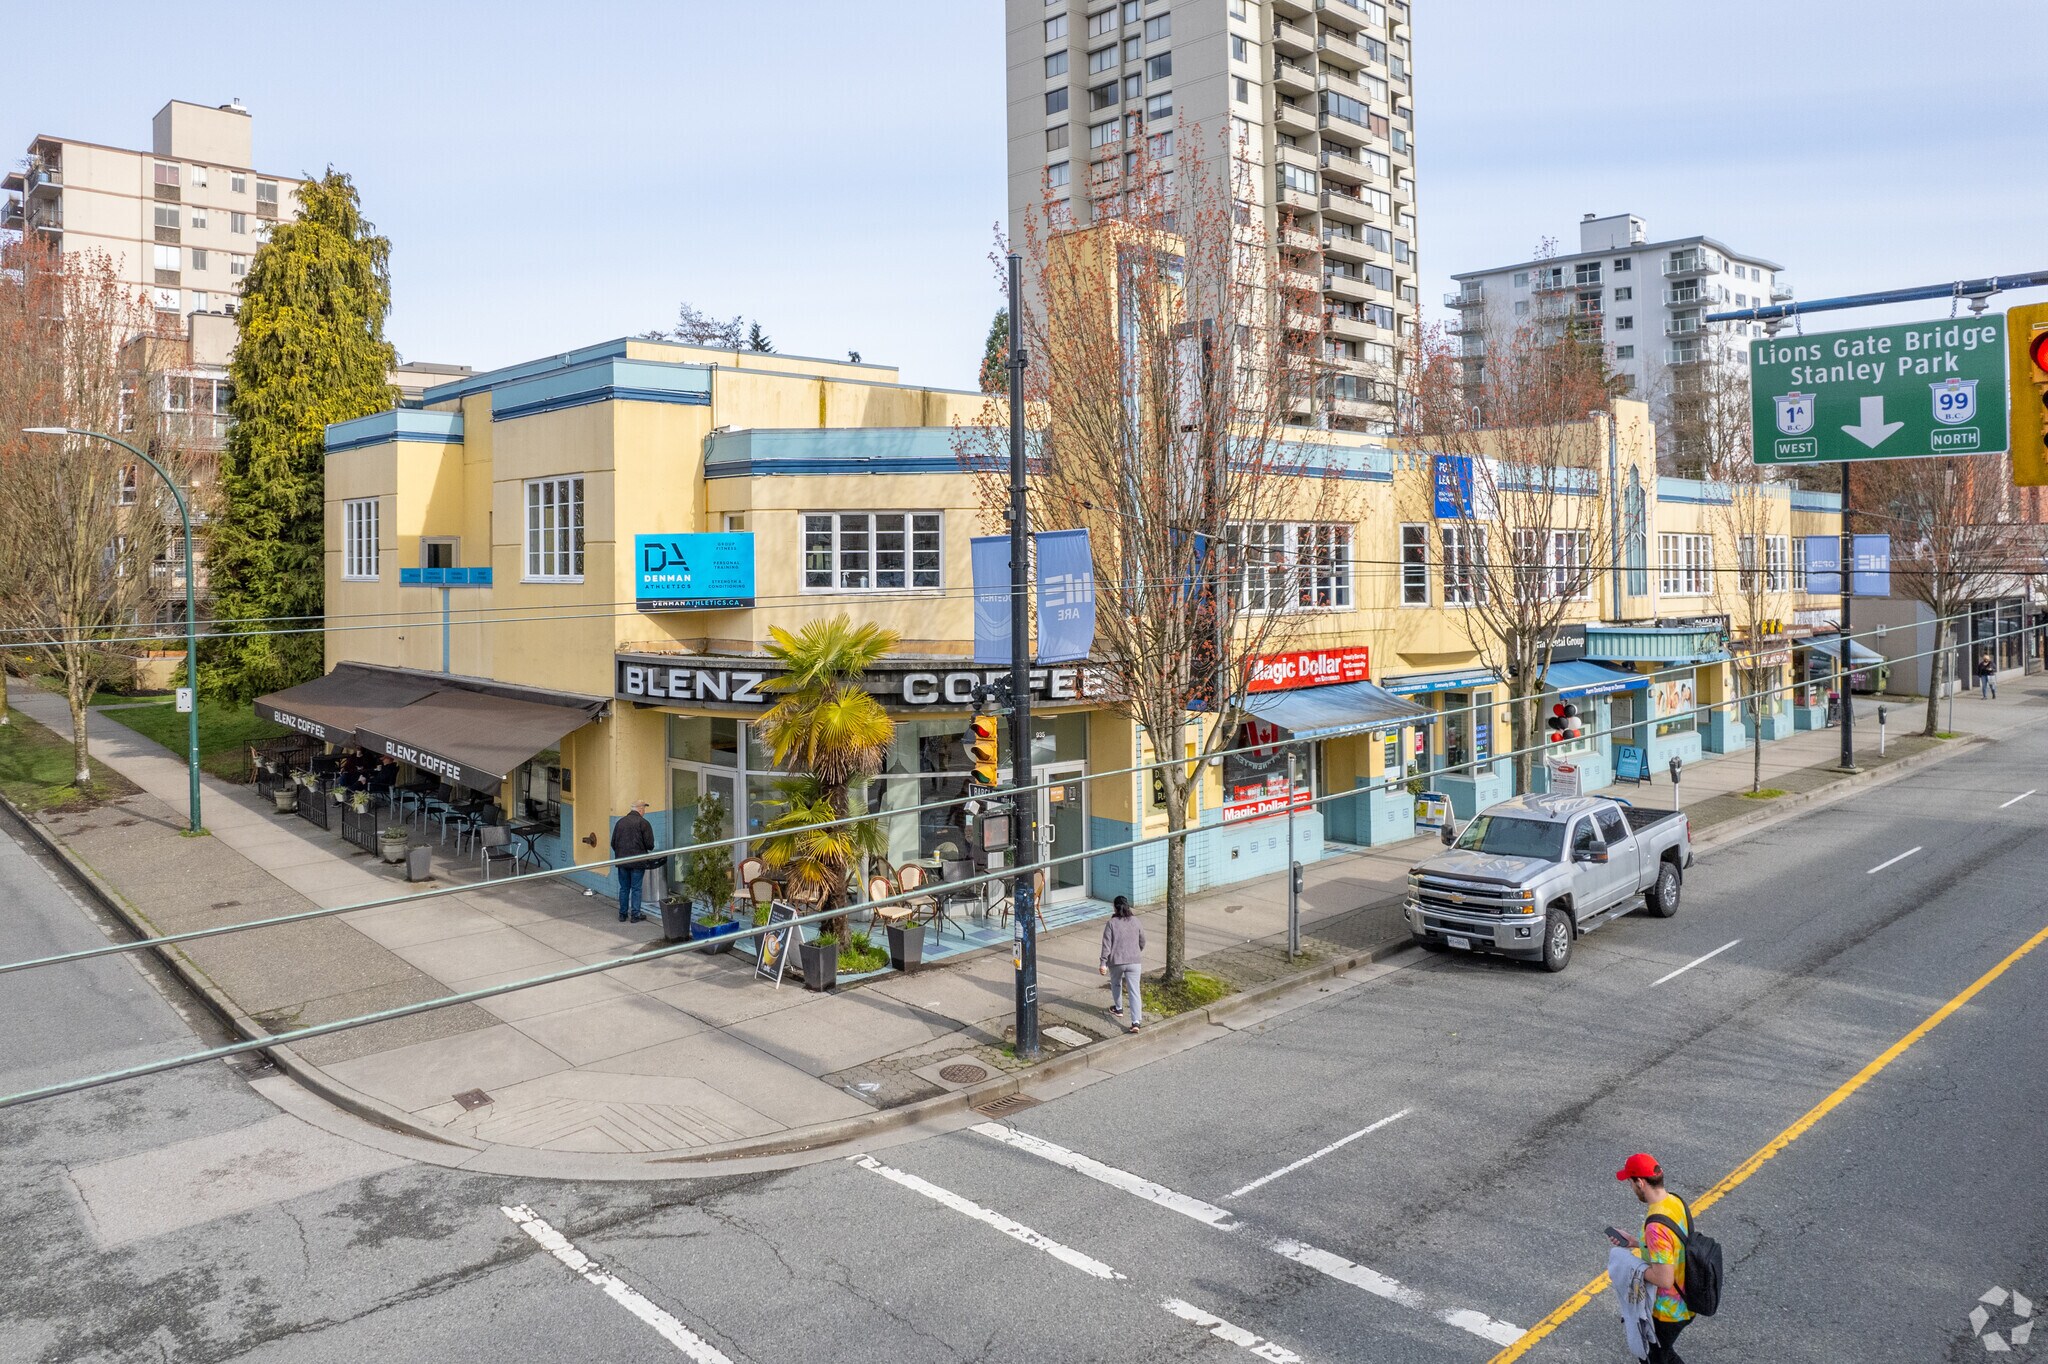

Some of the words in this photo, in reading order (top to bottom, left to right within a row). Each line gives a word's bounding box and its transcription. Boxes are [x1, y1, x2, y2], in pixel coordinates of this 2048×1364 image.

[1759, 344, 1821, 365] Lions
[1834, 335, 1891, 358] Gate
[1905, 326, 1996, 351] Bridge
[1791, 361, 1885, 385] Stanley
[1899, 351, 1959, 376] Park
[1939, 392, 1968, 411] 99
[1786, 406, 1804, 423] 1A
[1945, 412, 1964, 420] B.C.
[1779, 442, 1813, 454] WEST
[1933, 433, 1977, 446] NORTH
[644, 543, 690, 572] DA
[644, 574, 691, 583] DENMAN
[1566, 636, 1585, 648] Group
[1251, 657, 1296, 685] Magic
[1298, 654, 1341, 677] Dollar
[626, 666, 765, 703] BLENZ
[274, 710, 297, 728] BLENZ
[297, 718, 325, 738] COFFEE
[385, 741, 417, 763] BLENZ
[419, 752, 461, 780] COFFEE
[1224, 806, 1257, 821] Magic
[1257, 799, 1289, 813] Dollar
